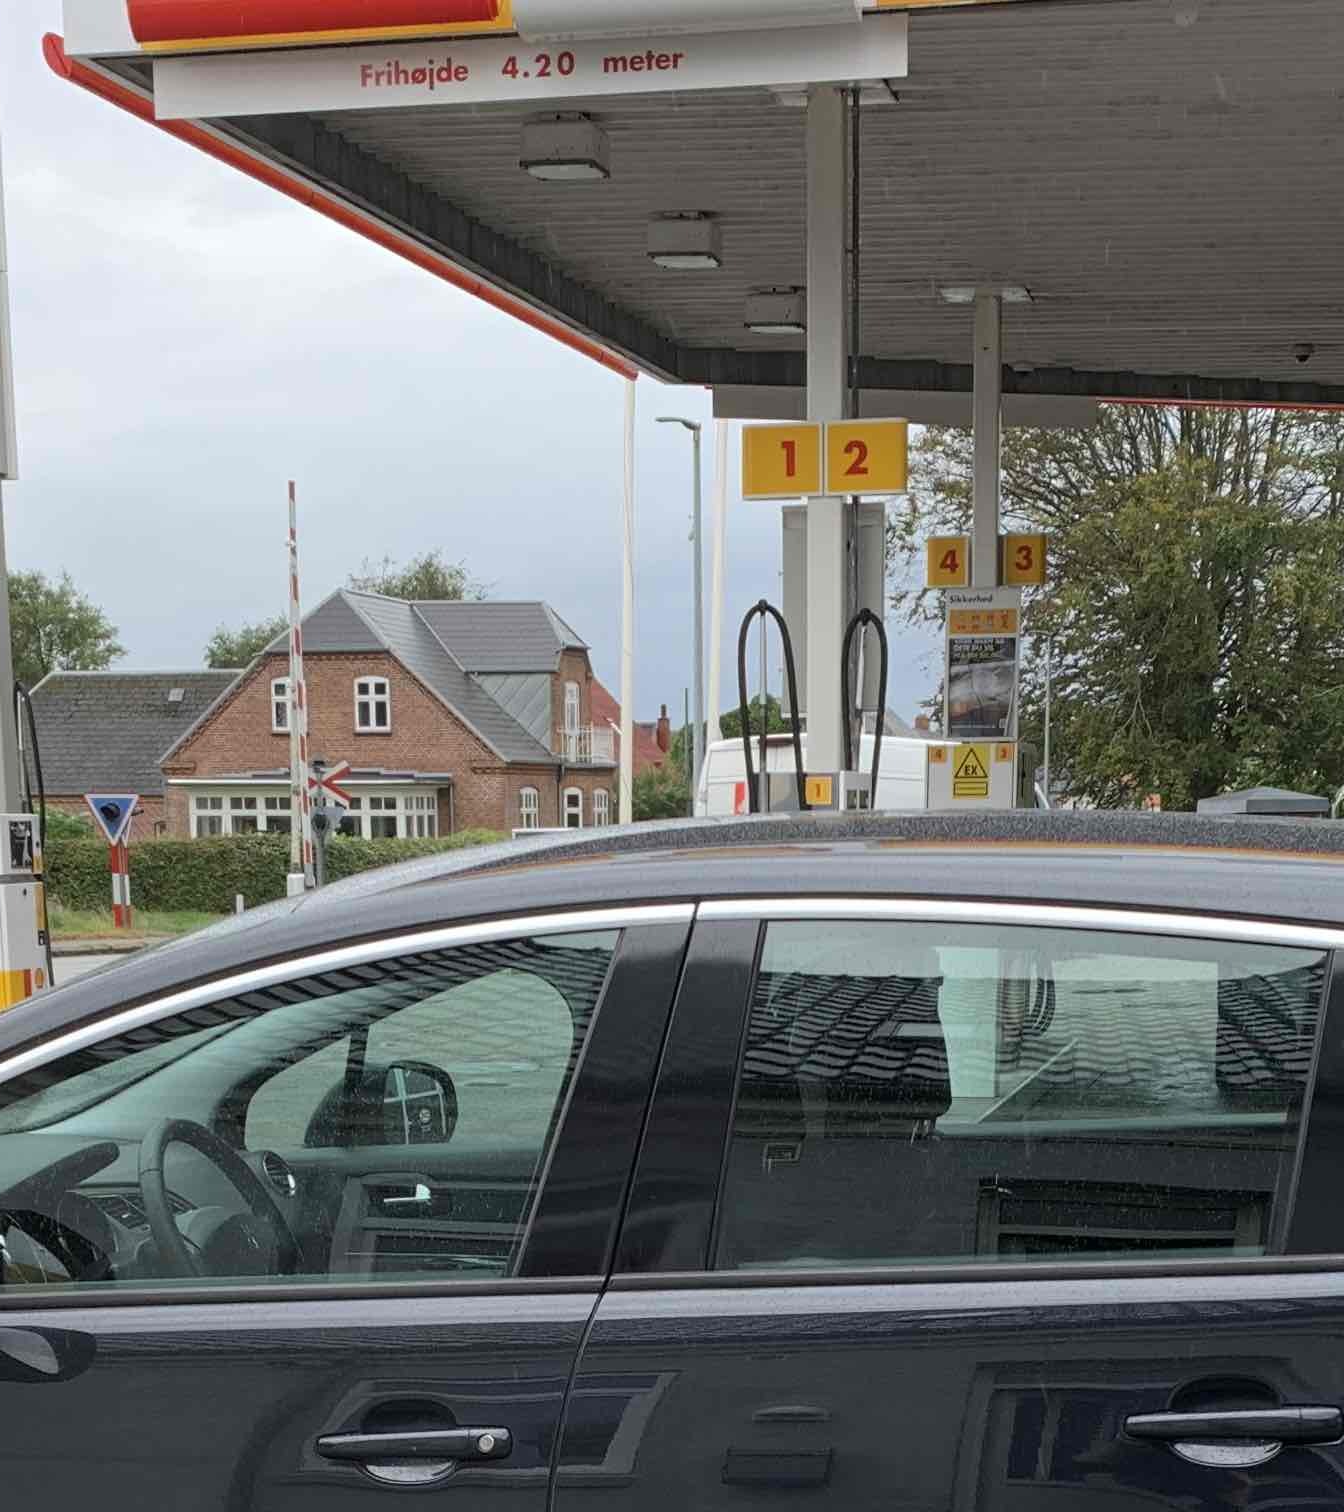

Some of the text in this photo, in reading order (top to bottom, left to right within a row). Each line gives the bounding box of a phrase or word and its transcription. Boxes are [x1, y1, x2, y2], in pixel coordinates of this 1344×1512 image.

[360, 49, 684, 90] Frihøjde 4.20 meter
[782, 441, 795, 476] 1
[843, 440, 868, 475] 2
[940, 549, 959, 573] 4
[1016, 545, 1033, 571] 3
